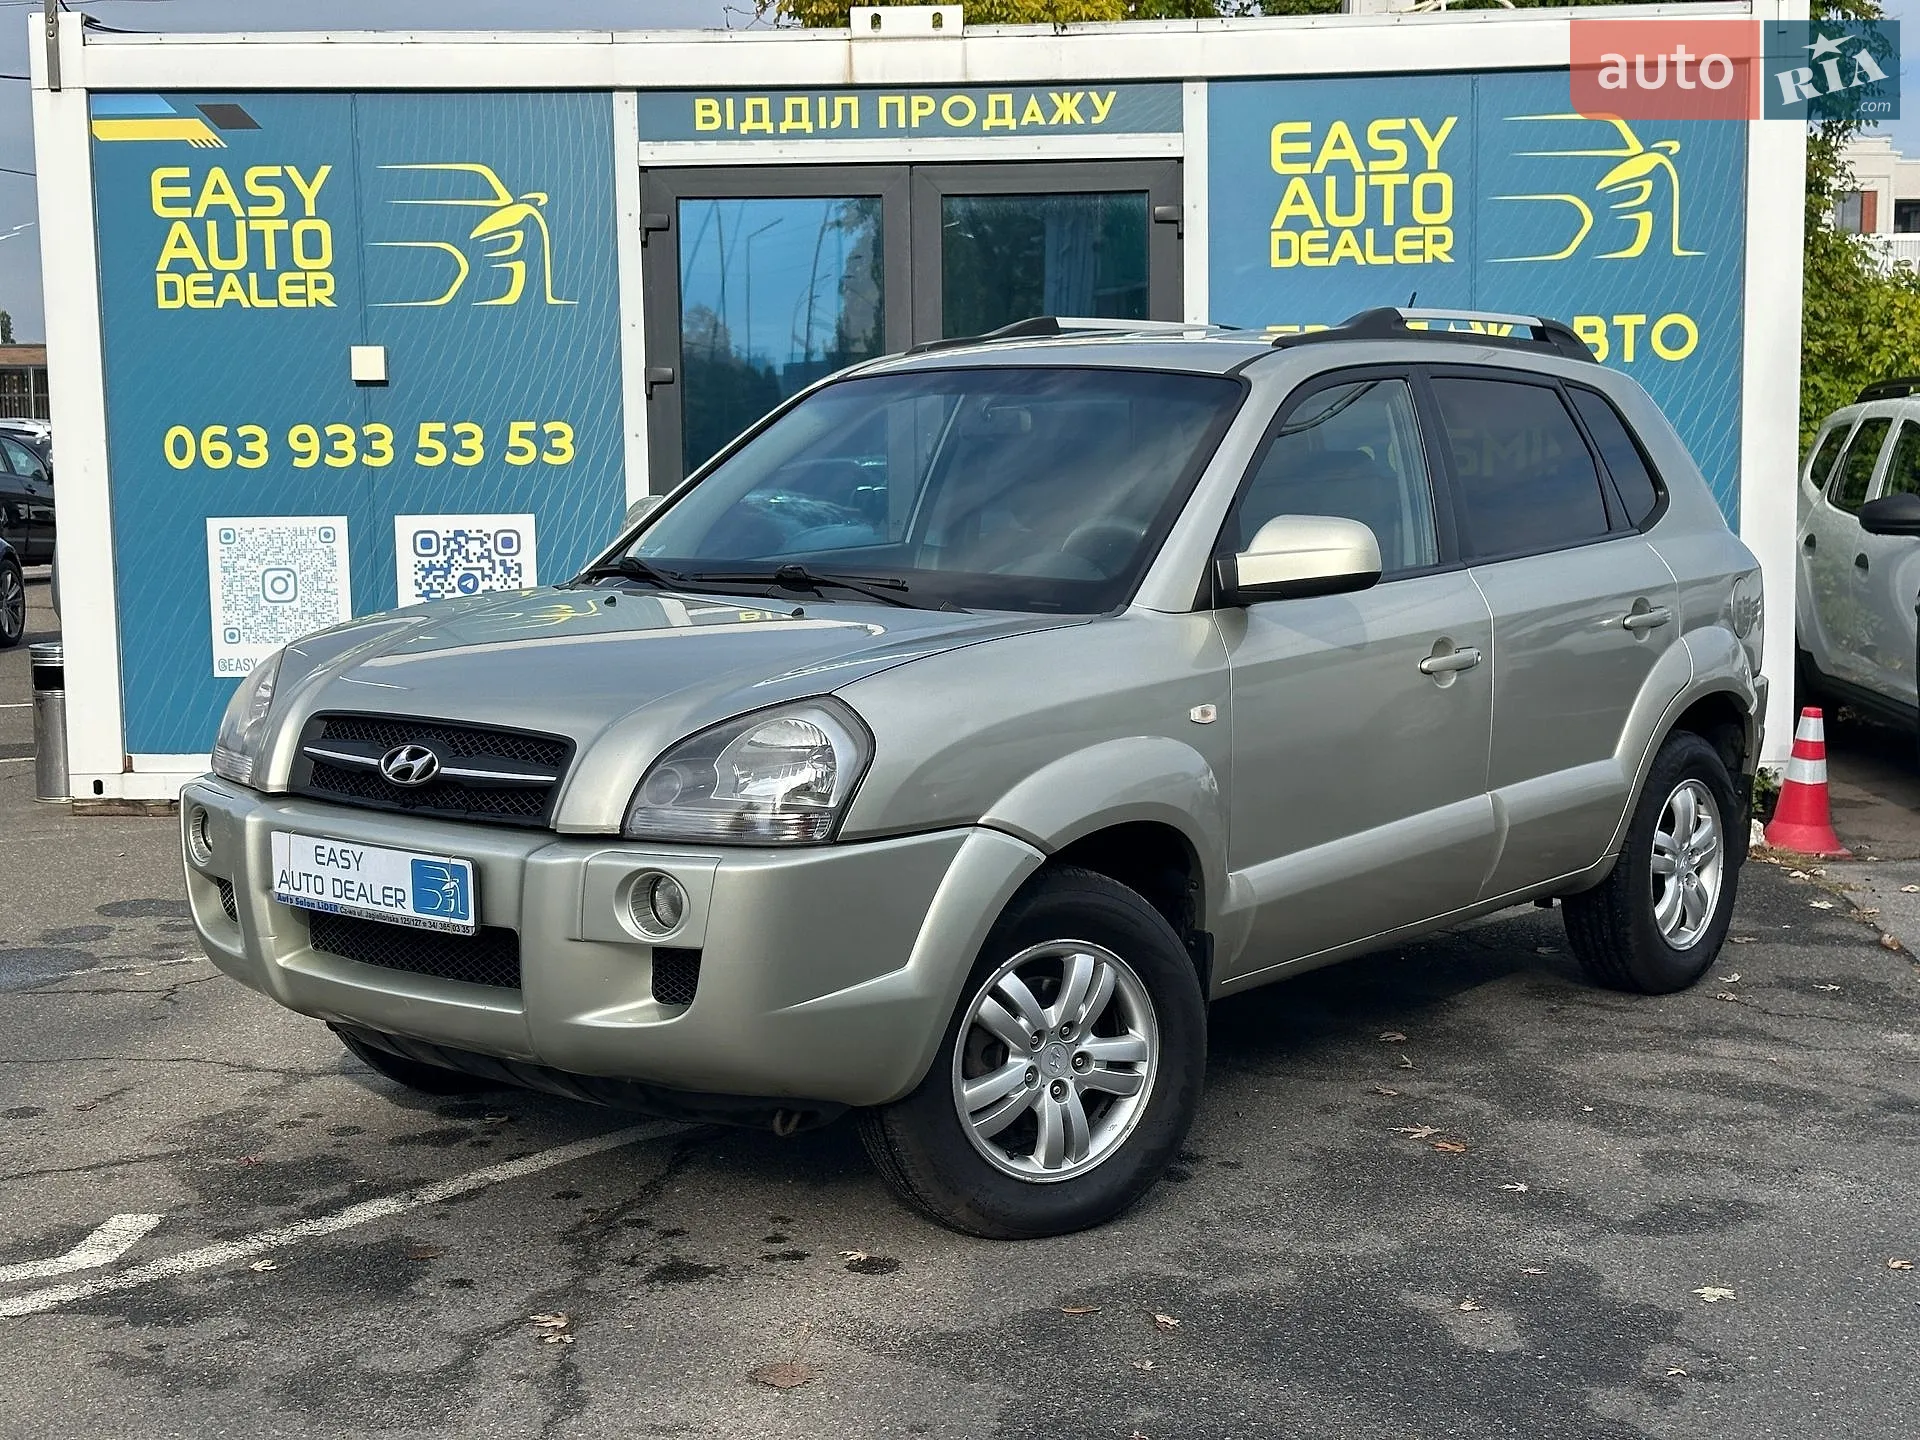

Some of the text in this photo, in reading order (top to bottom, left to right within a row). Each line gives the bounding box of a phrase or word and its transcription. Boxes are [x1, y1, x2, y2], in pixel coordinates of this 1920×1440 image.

[694, 90, 1117, 134] ВІДДІЛ ПРОДАЖУ
[1270, 116, 1458, 174] EASY
[150, 165, 332, 218] EASY
[1271, 172, 1454, 229] AUTO
[155, 219, 333, 271] AUTO
[1270, 226, 1455, 267] DEALER
[156, 272, 337, 309] DEALER
[1573, 313, 1699, 362] ВТО
[164, 421, 575, 470] 063 933 53 53
[314, 845, 363, 872] EASY
[278, 870, 406, 909] AUTO DEALER
